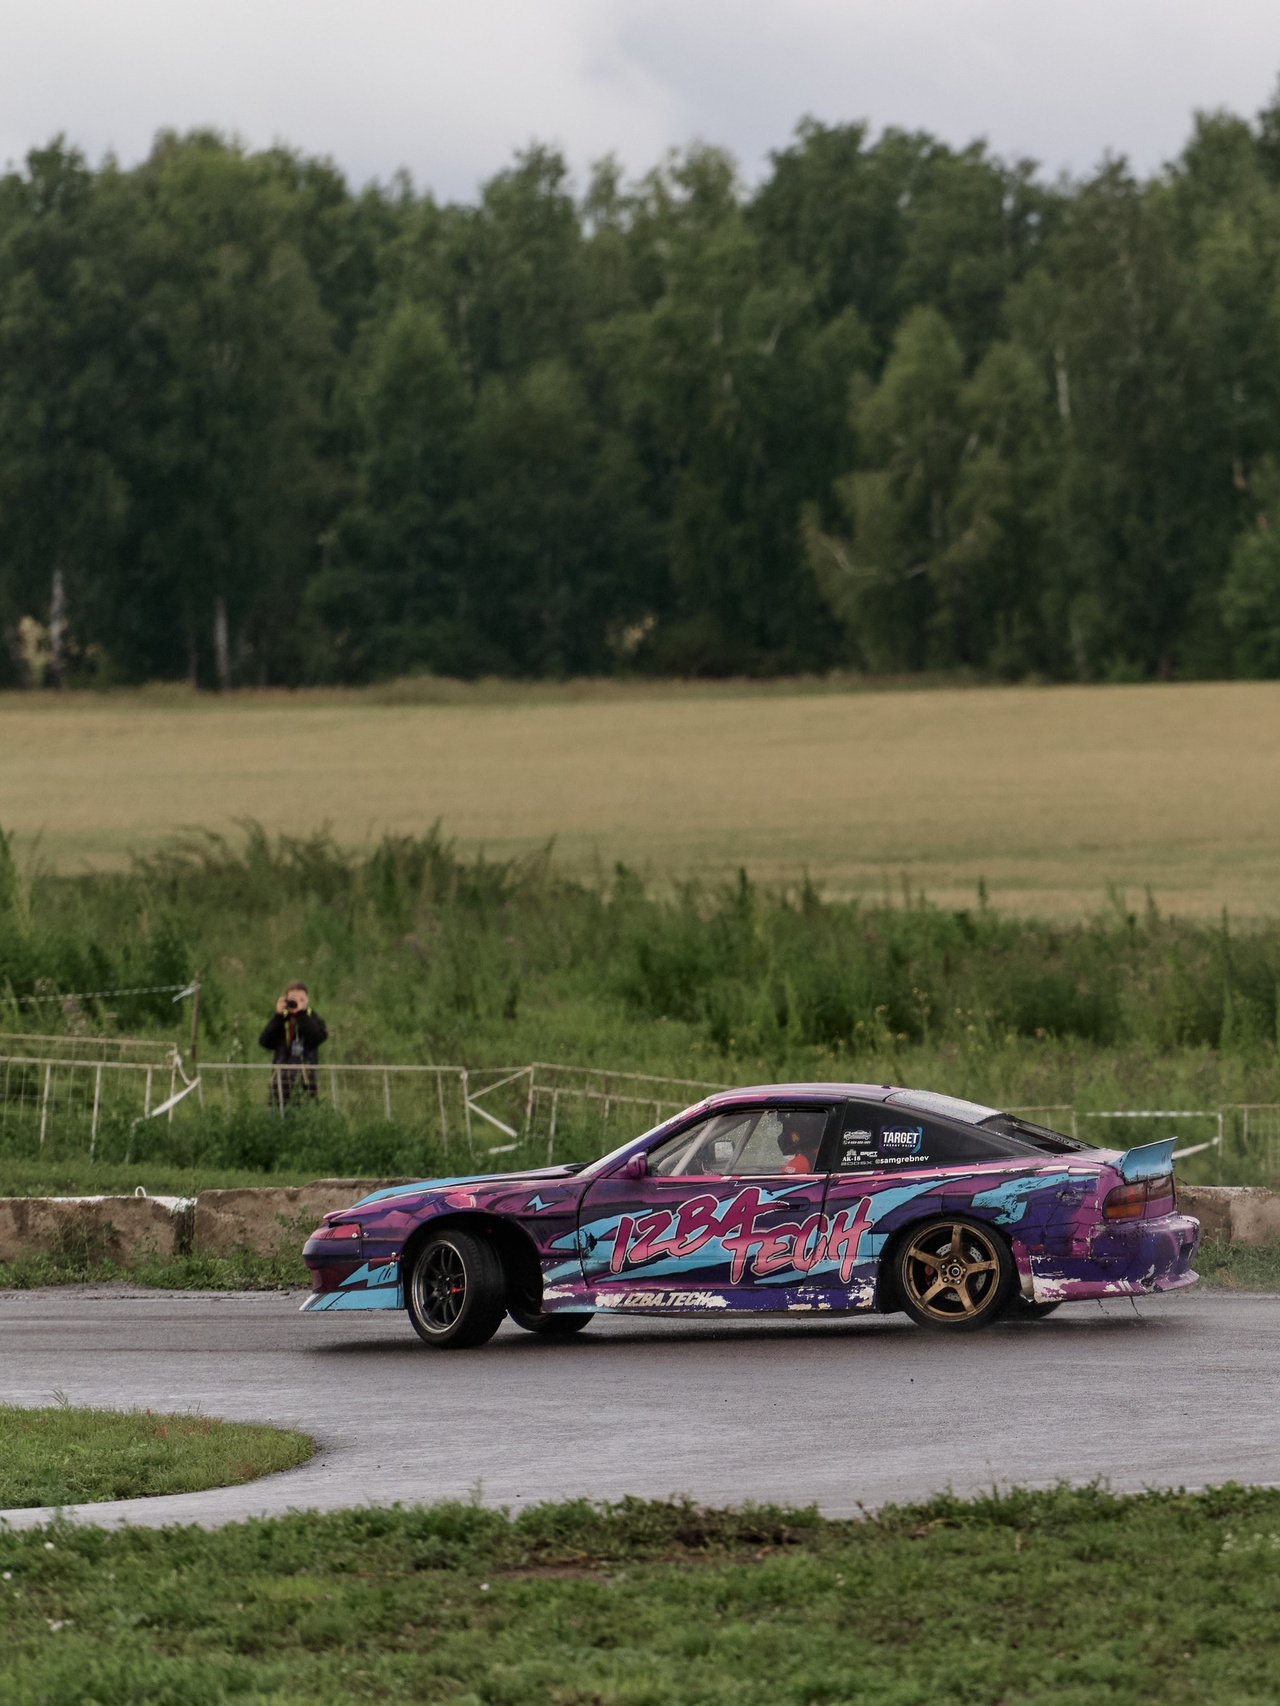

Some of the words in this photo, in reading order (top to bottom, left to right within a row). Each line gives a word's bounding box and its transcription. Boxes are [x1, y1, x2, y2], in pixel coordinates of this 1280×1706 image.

[875, 1155, 929, 1164] @samgrebnev
[883, 1132, 920, 1144] TARGET
[610, 1186, 790, 1274] IZBA
[721, 1197, 874, 1284] TECH
